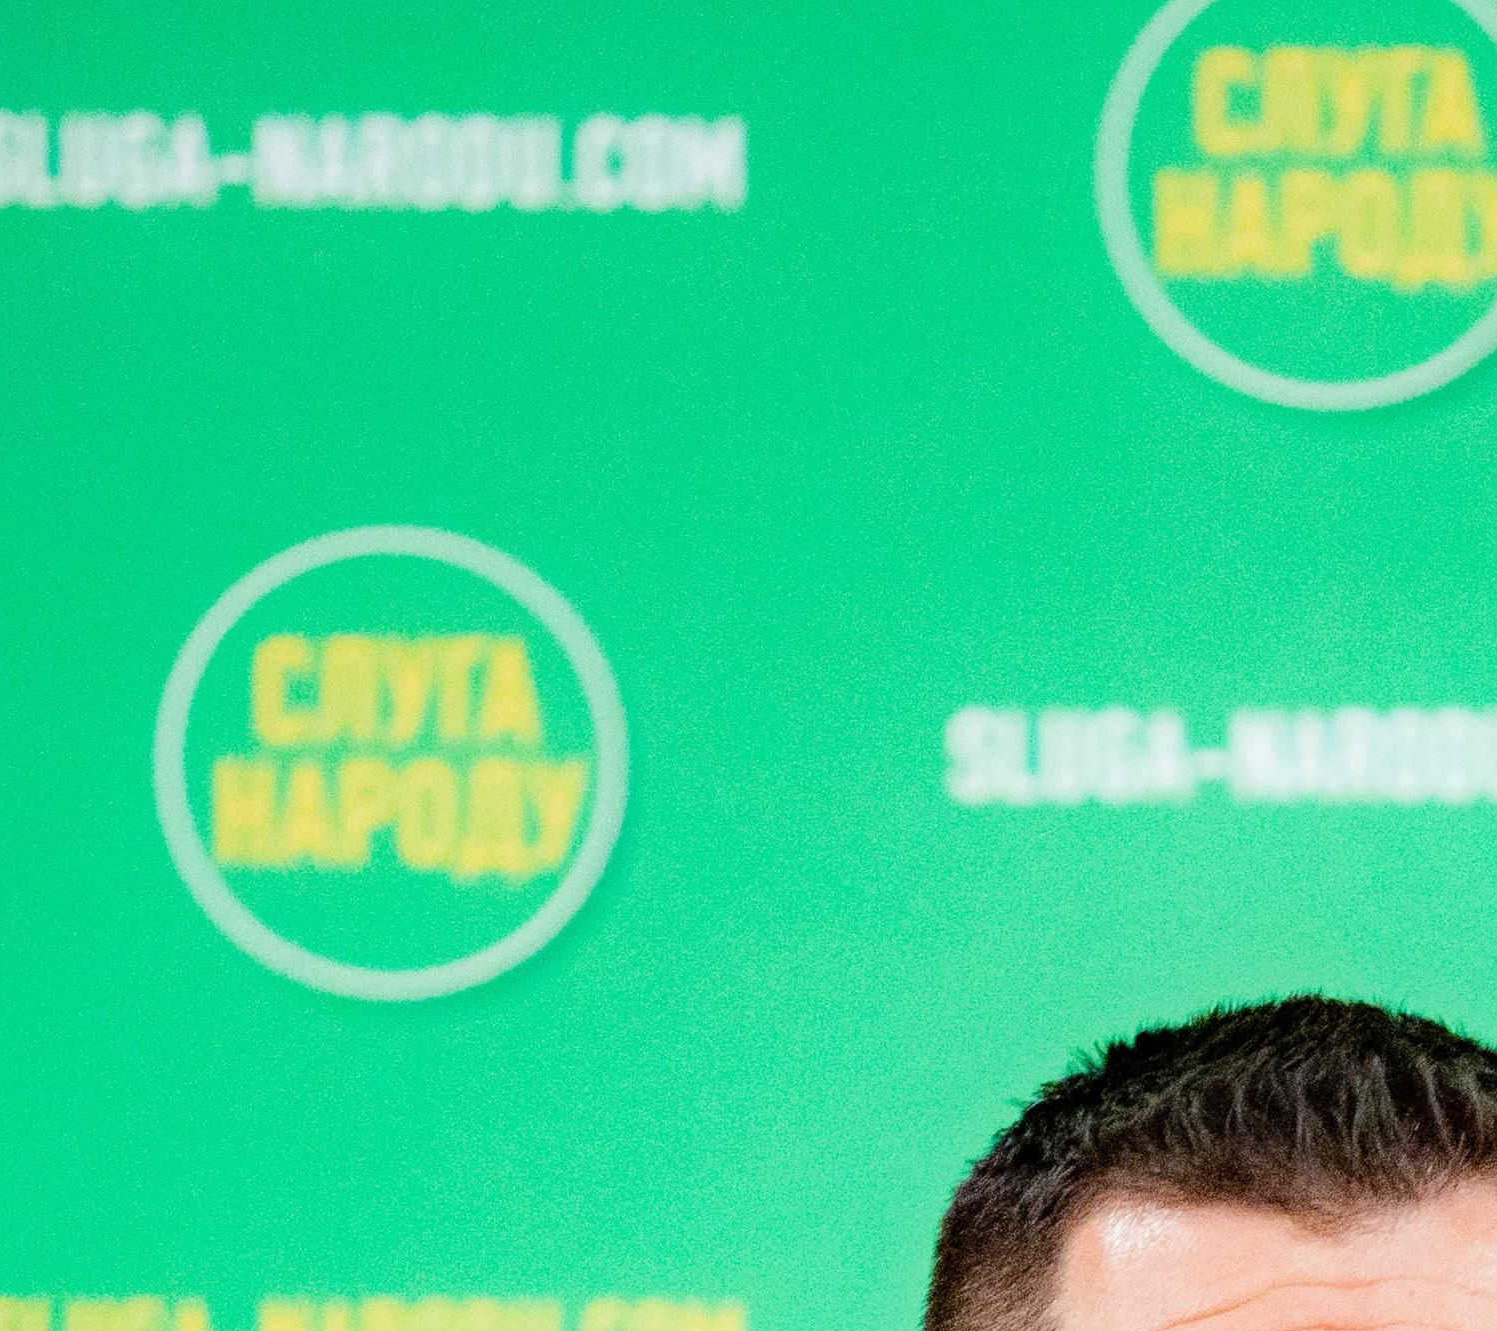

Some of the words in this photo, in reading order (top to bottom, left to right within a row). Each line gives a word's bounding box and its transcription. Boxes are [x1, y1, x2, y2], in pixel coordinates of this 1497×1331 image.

[1193, 45, 1486, 157] СЛУГА
[252, 634, 542, 749] СЛУГА
[210, 751, 588, 883] НАРОДУ
